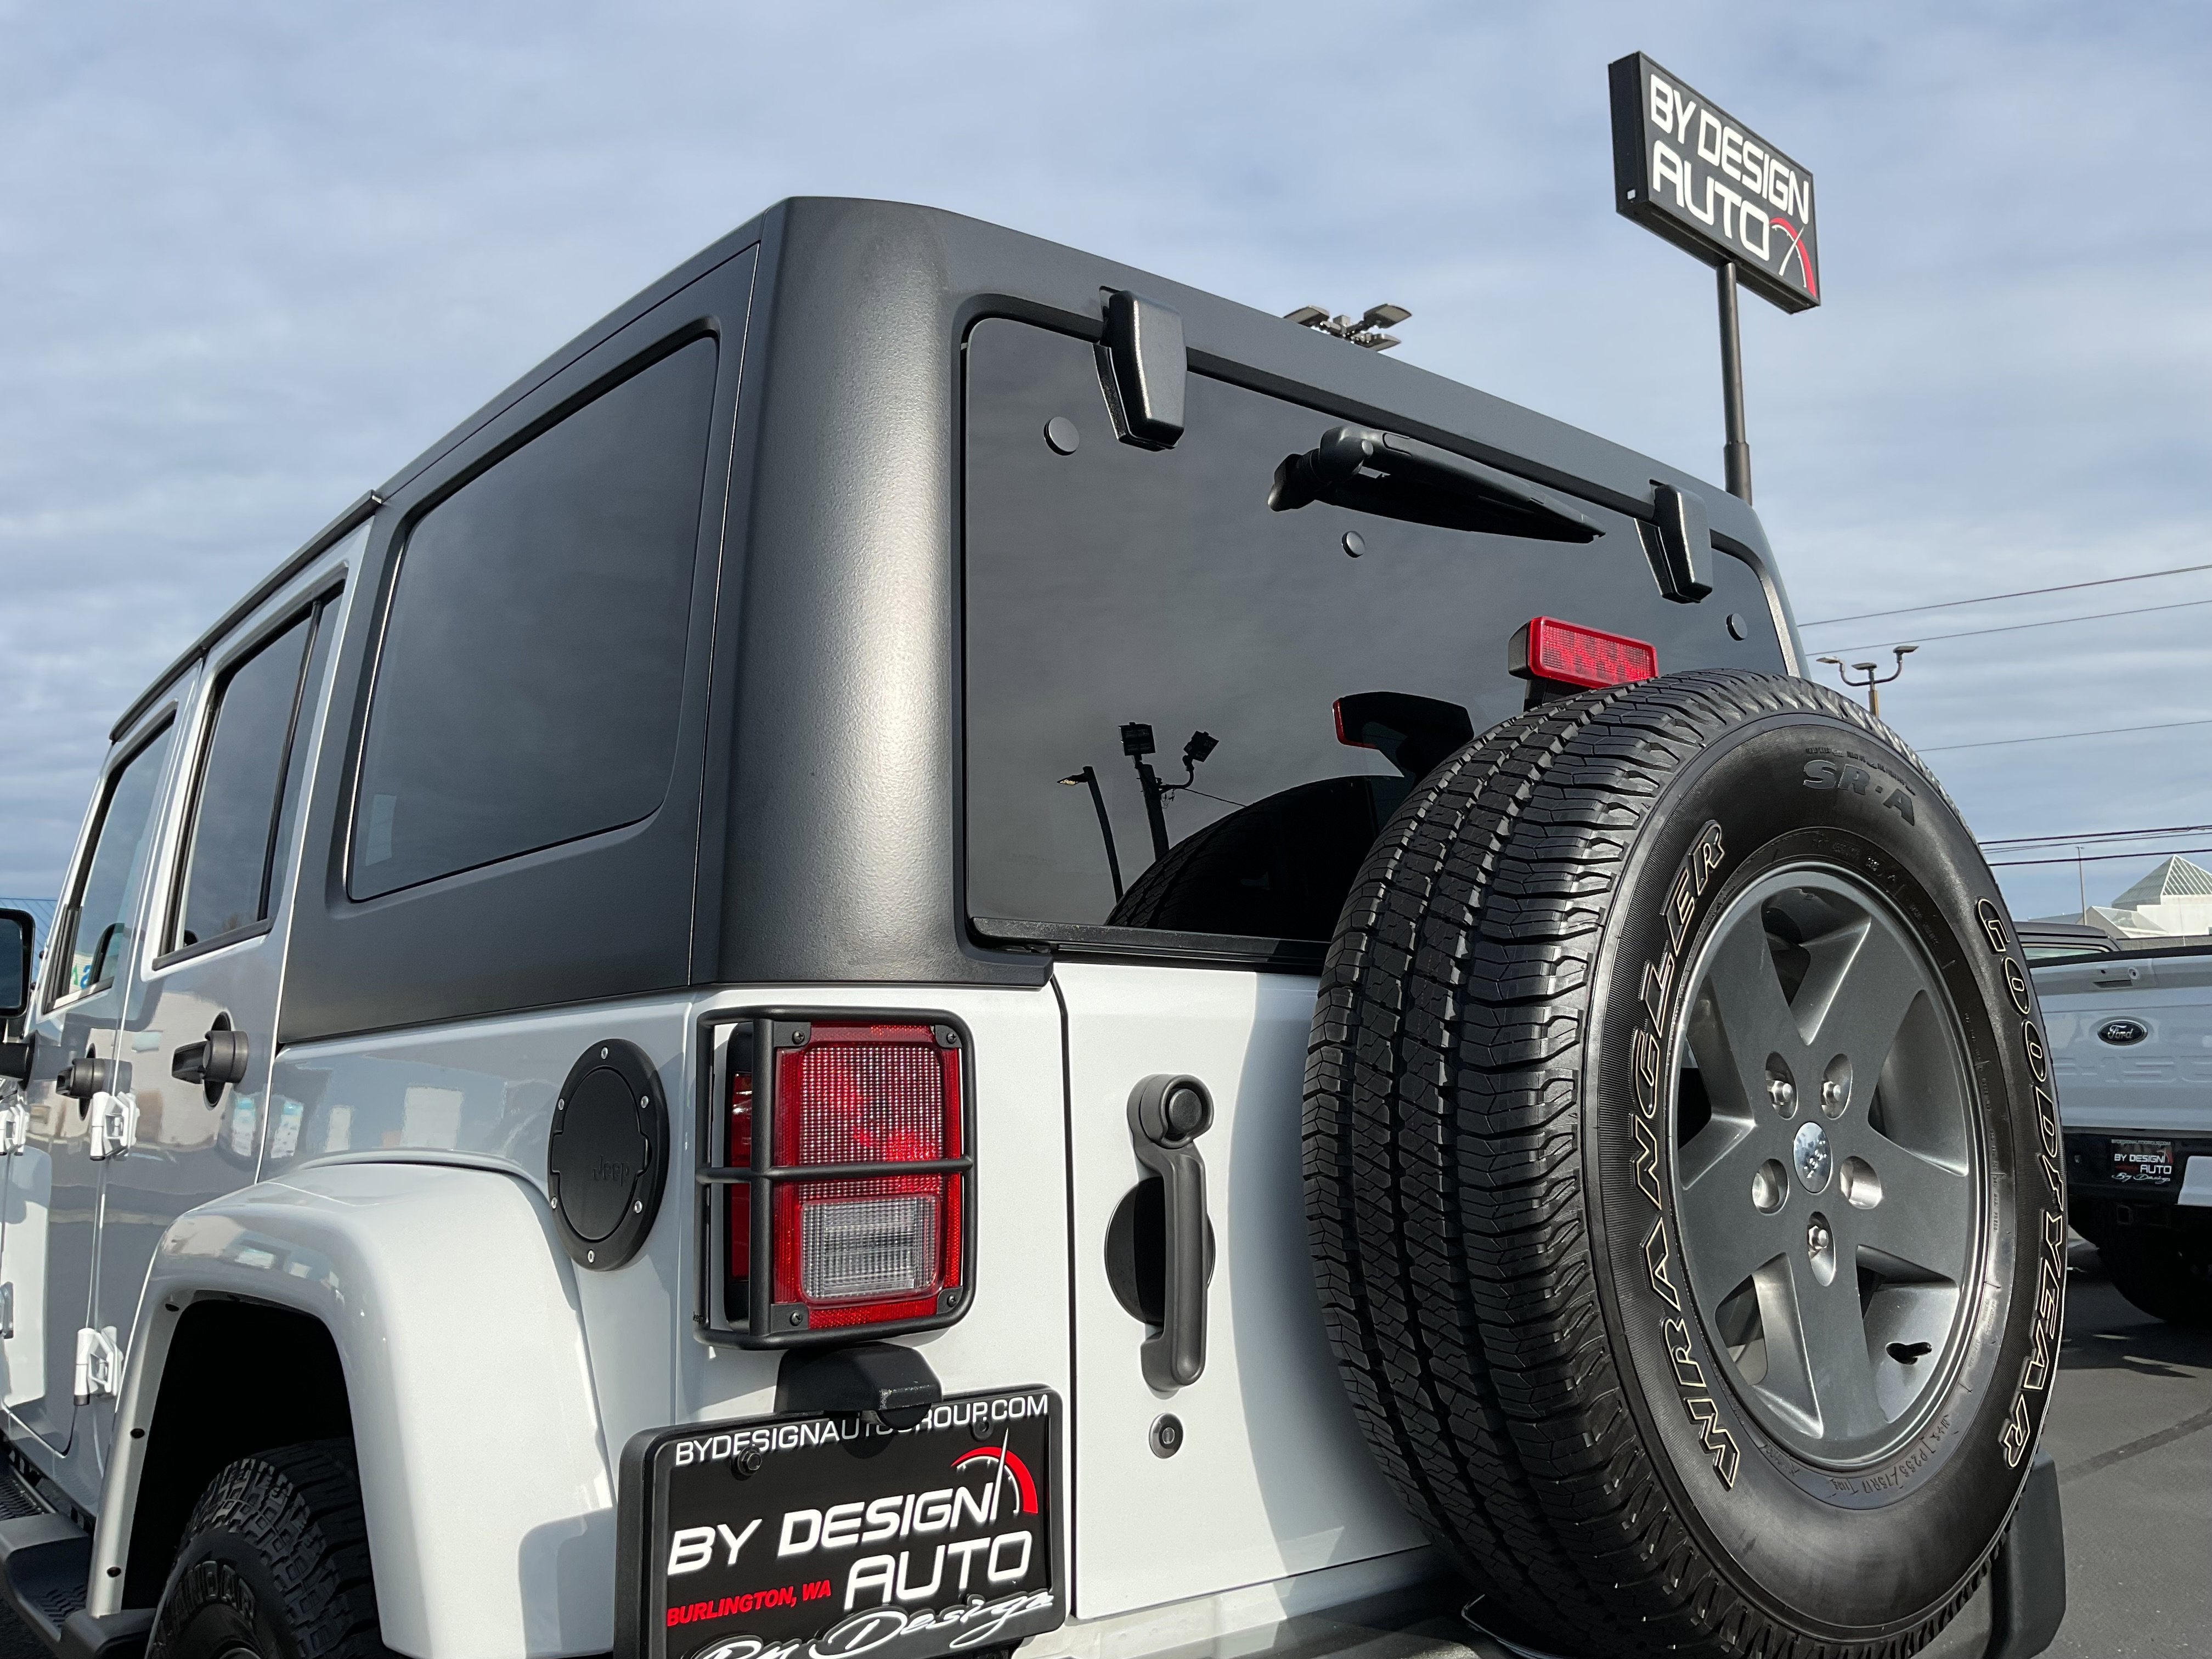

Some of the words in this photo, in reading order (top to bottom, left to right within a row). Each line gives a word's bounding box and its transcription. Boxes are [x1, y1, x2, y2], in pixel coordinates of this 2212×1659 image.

[1651, 74, 1696, 144] BY
[1698, 109, 1809, 224] DESIGN
[1653, 140, 1769, 261] AUTO
[2107, 1024, 2134, 1040] Ford
[592, 1154, 630, 1187] Jeep
[1629, 821, 1737, 1488] WRANGLER
[1976, 899, 2063, 1469] GOODYEAR
[2114, 1153, 2127, 1162] BY
[2129, 1154, 2164, 1163] DESIGN
[2140, 1164, 2172, 1175] AUTO
[675, 1394, 1048, 1466] BYDESIGNAUROUP.COM
[1862, 1448, 1928, 1493] P255/75R17
[667, 1518, 763, 1576] BY
[777, 1482, 995, 1559] DESIGN
[666, 1585, 797, 1627] BURLINGTON,
[802, 1579, 832, 1599] WA
[843, 1531, 1033, 1611] AUTO
[808, 1590, 1054, 1659] Design
